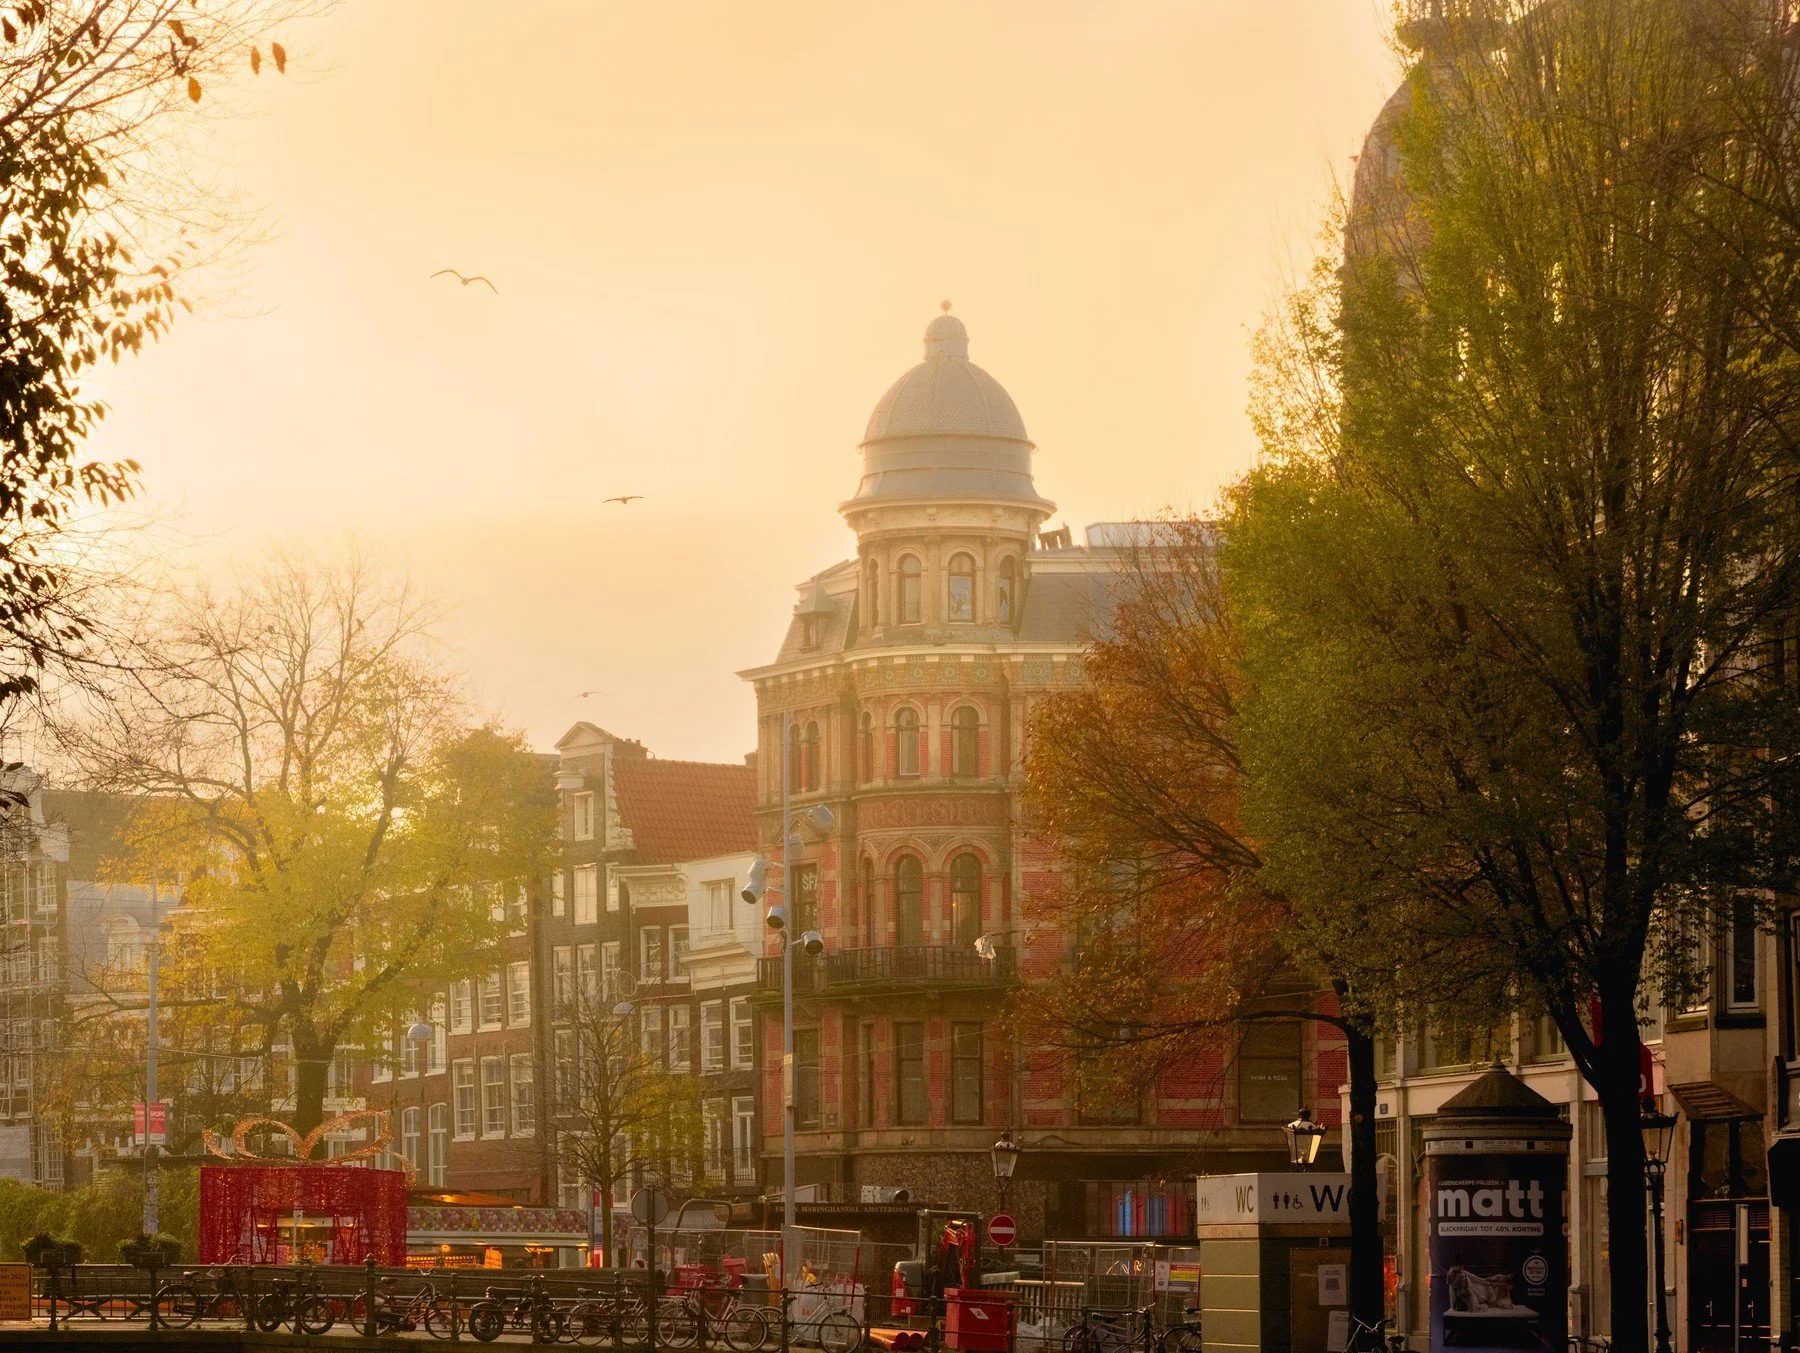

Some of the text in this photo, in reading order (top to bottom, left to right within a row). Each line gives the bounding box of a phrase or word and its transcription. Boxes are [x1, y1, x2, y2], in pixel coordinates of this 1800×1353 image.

[801, 1205, 860, 1213] HARINGHANDEL
[863, 1205, 910, 1213] AMSTERDAM
[1235, 1185, 1254, 1214] WC
[1309, 1184, 1352, 1213] W
[1437, 1179, 1545, 1218] matt
